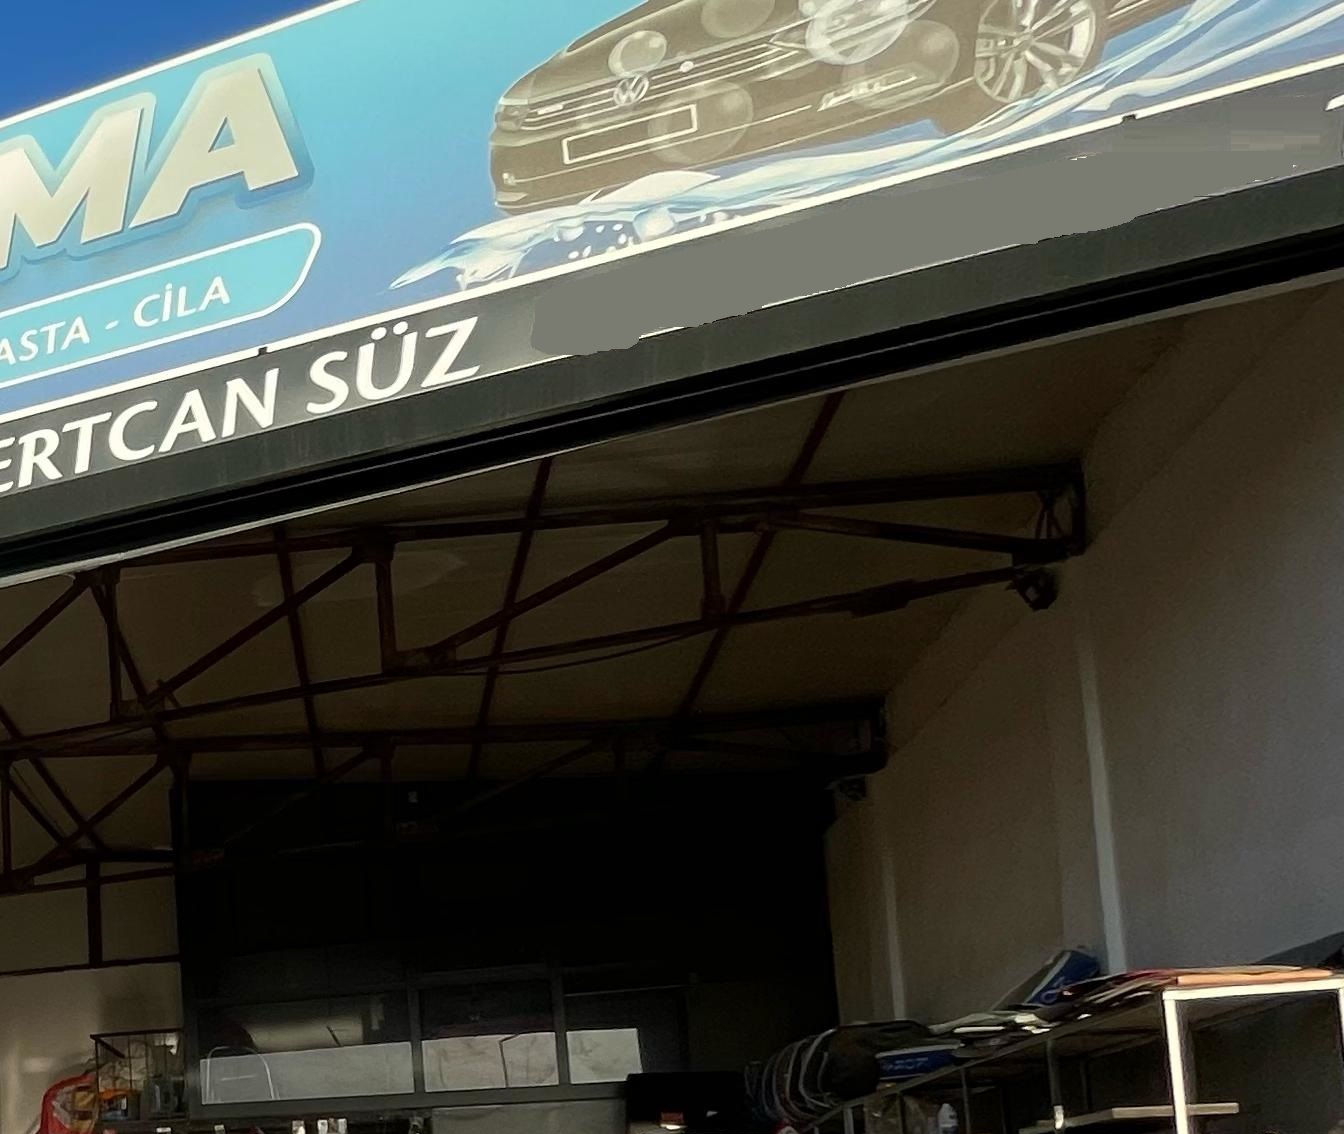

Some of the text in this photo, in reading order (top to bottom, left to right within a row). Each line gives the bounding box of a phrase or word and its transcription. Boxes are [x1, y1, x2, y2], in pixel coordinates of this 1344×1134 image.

[105, 319, 120, 331] -
[132, 275, 230, 328] CİLA
[305, 316, 481, 415] SÜZ
